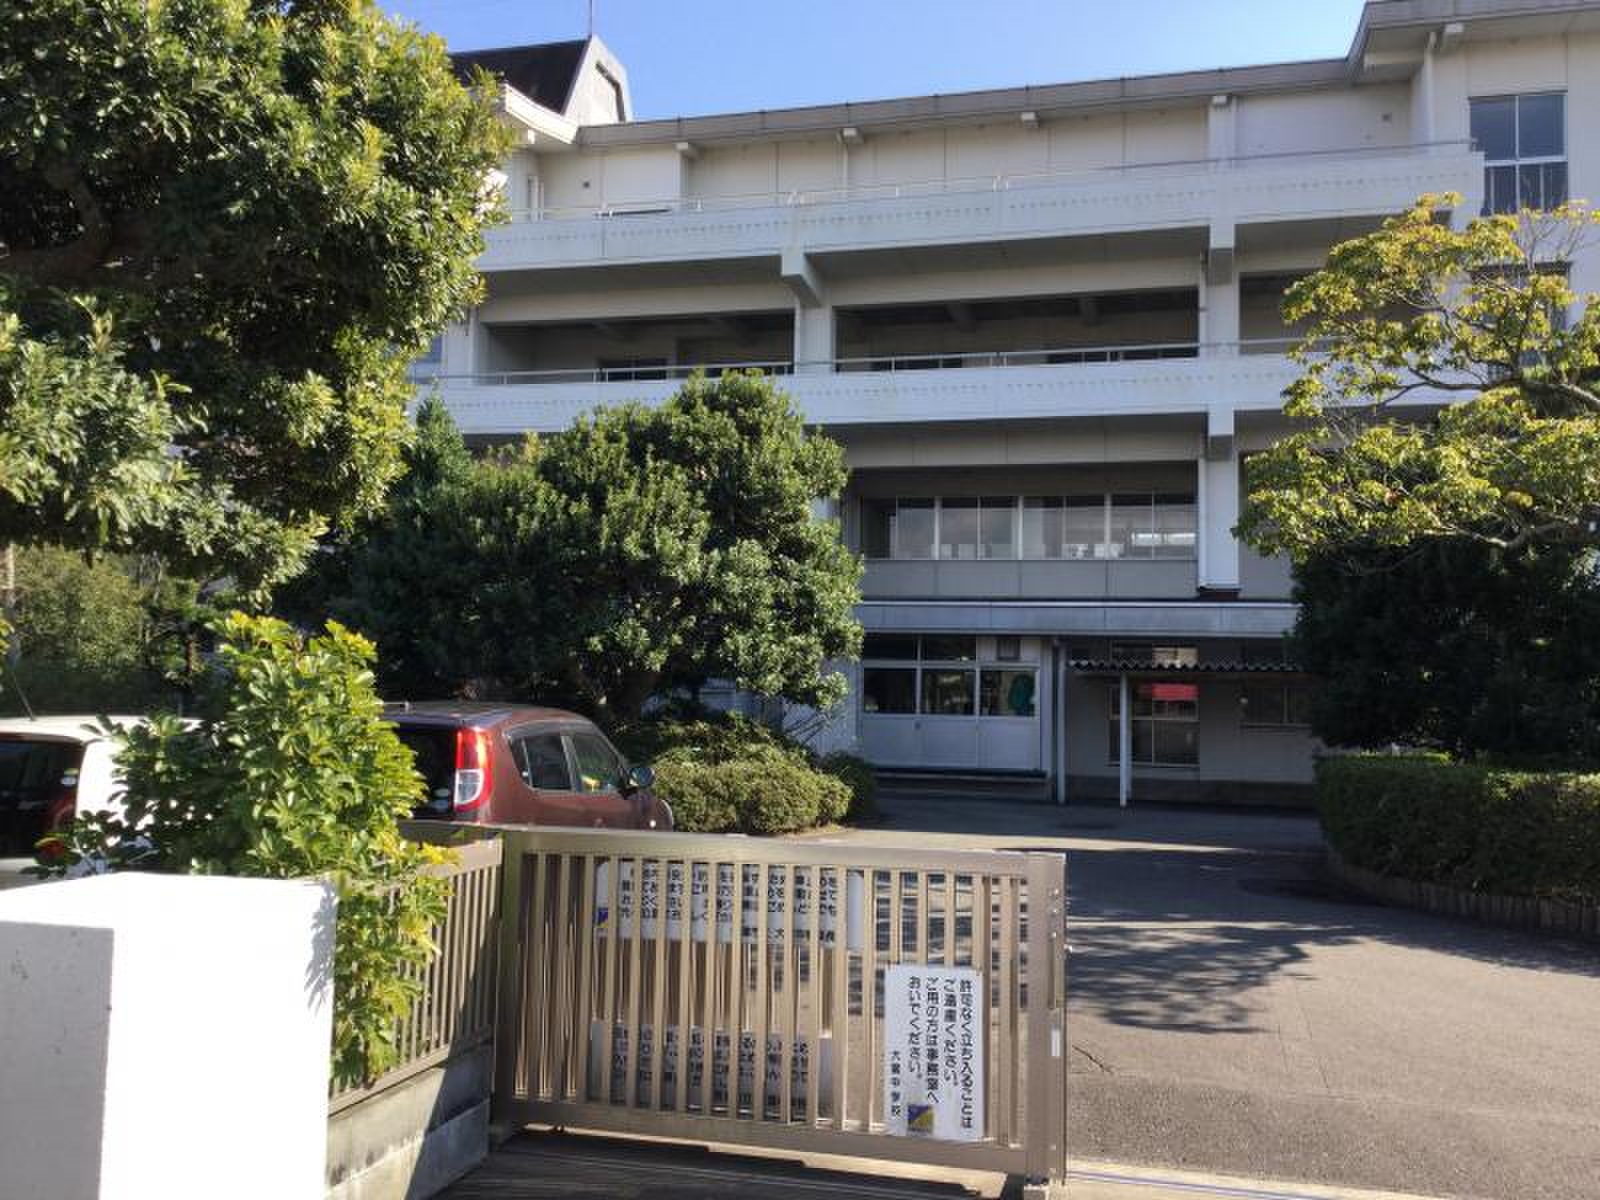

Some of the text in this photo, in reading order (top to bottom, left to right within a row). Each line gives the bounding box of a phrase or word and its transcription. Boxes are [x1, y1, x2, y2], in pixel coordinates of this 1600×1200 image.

[909, 976, 923, 1079] おいでください。
